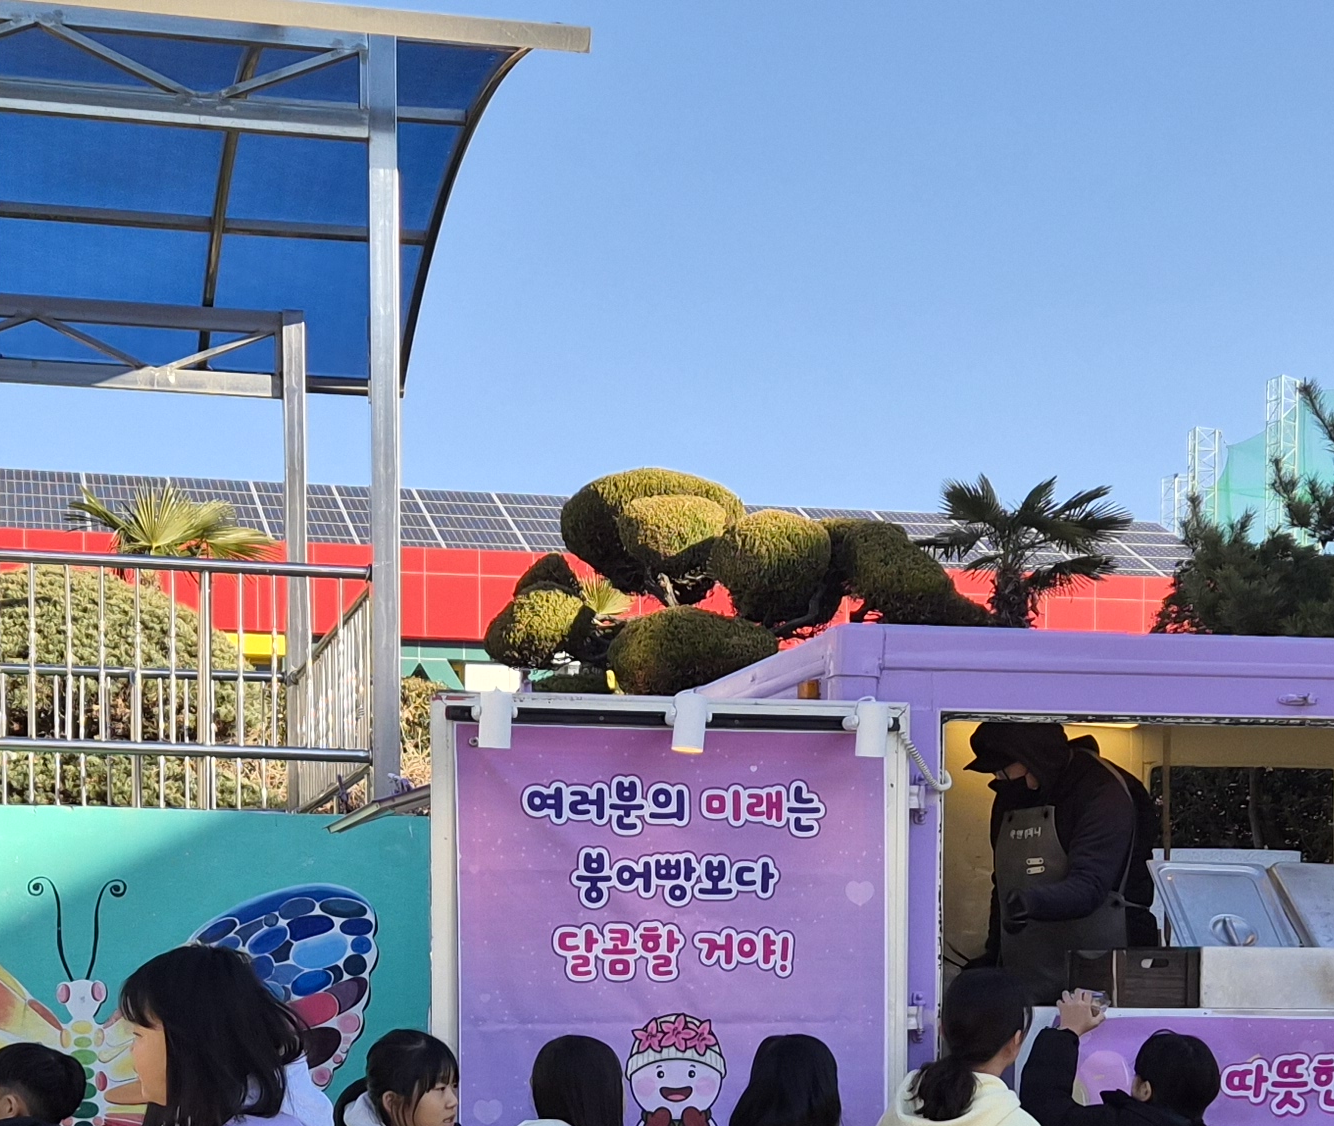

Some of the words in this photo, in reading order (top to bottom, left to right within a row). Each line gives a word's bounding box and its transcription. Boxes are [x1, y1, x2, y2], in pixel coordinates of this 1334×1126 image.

[523, 777, 691, 836] 여러분의
[700, 781, 827, 837] 미래는
[570, 846, 779, 908] 붕어빵보다
[552, 921, 687, 982] 달콤할
[693, 926, 795, 978] 거야!
